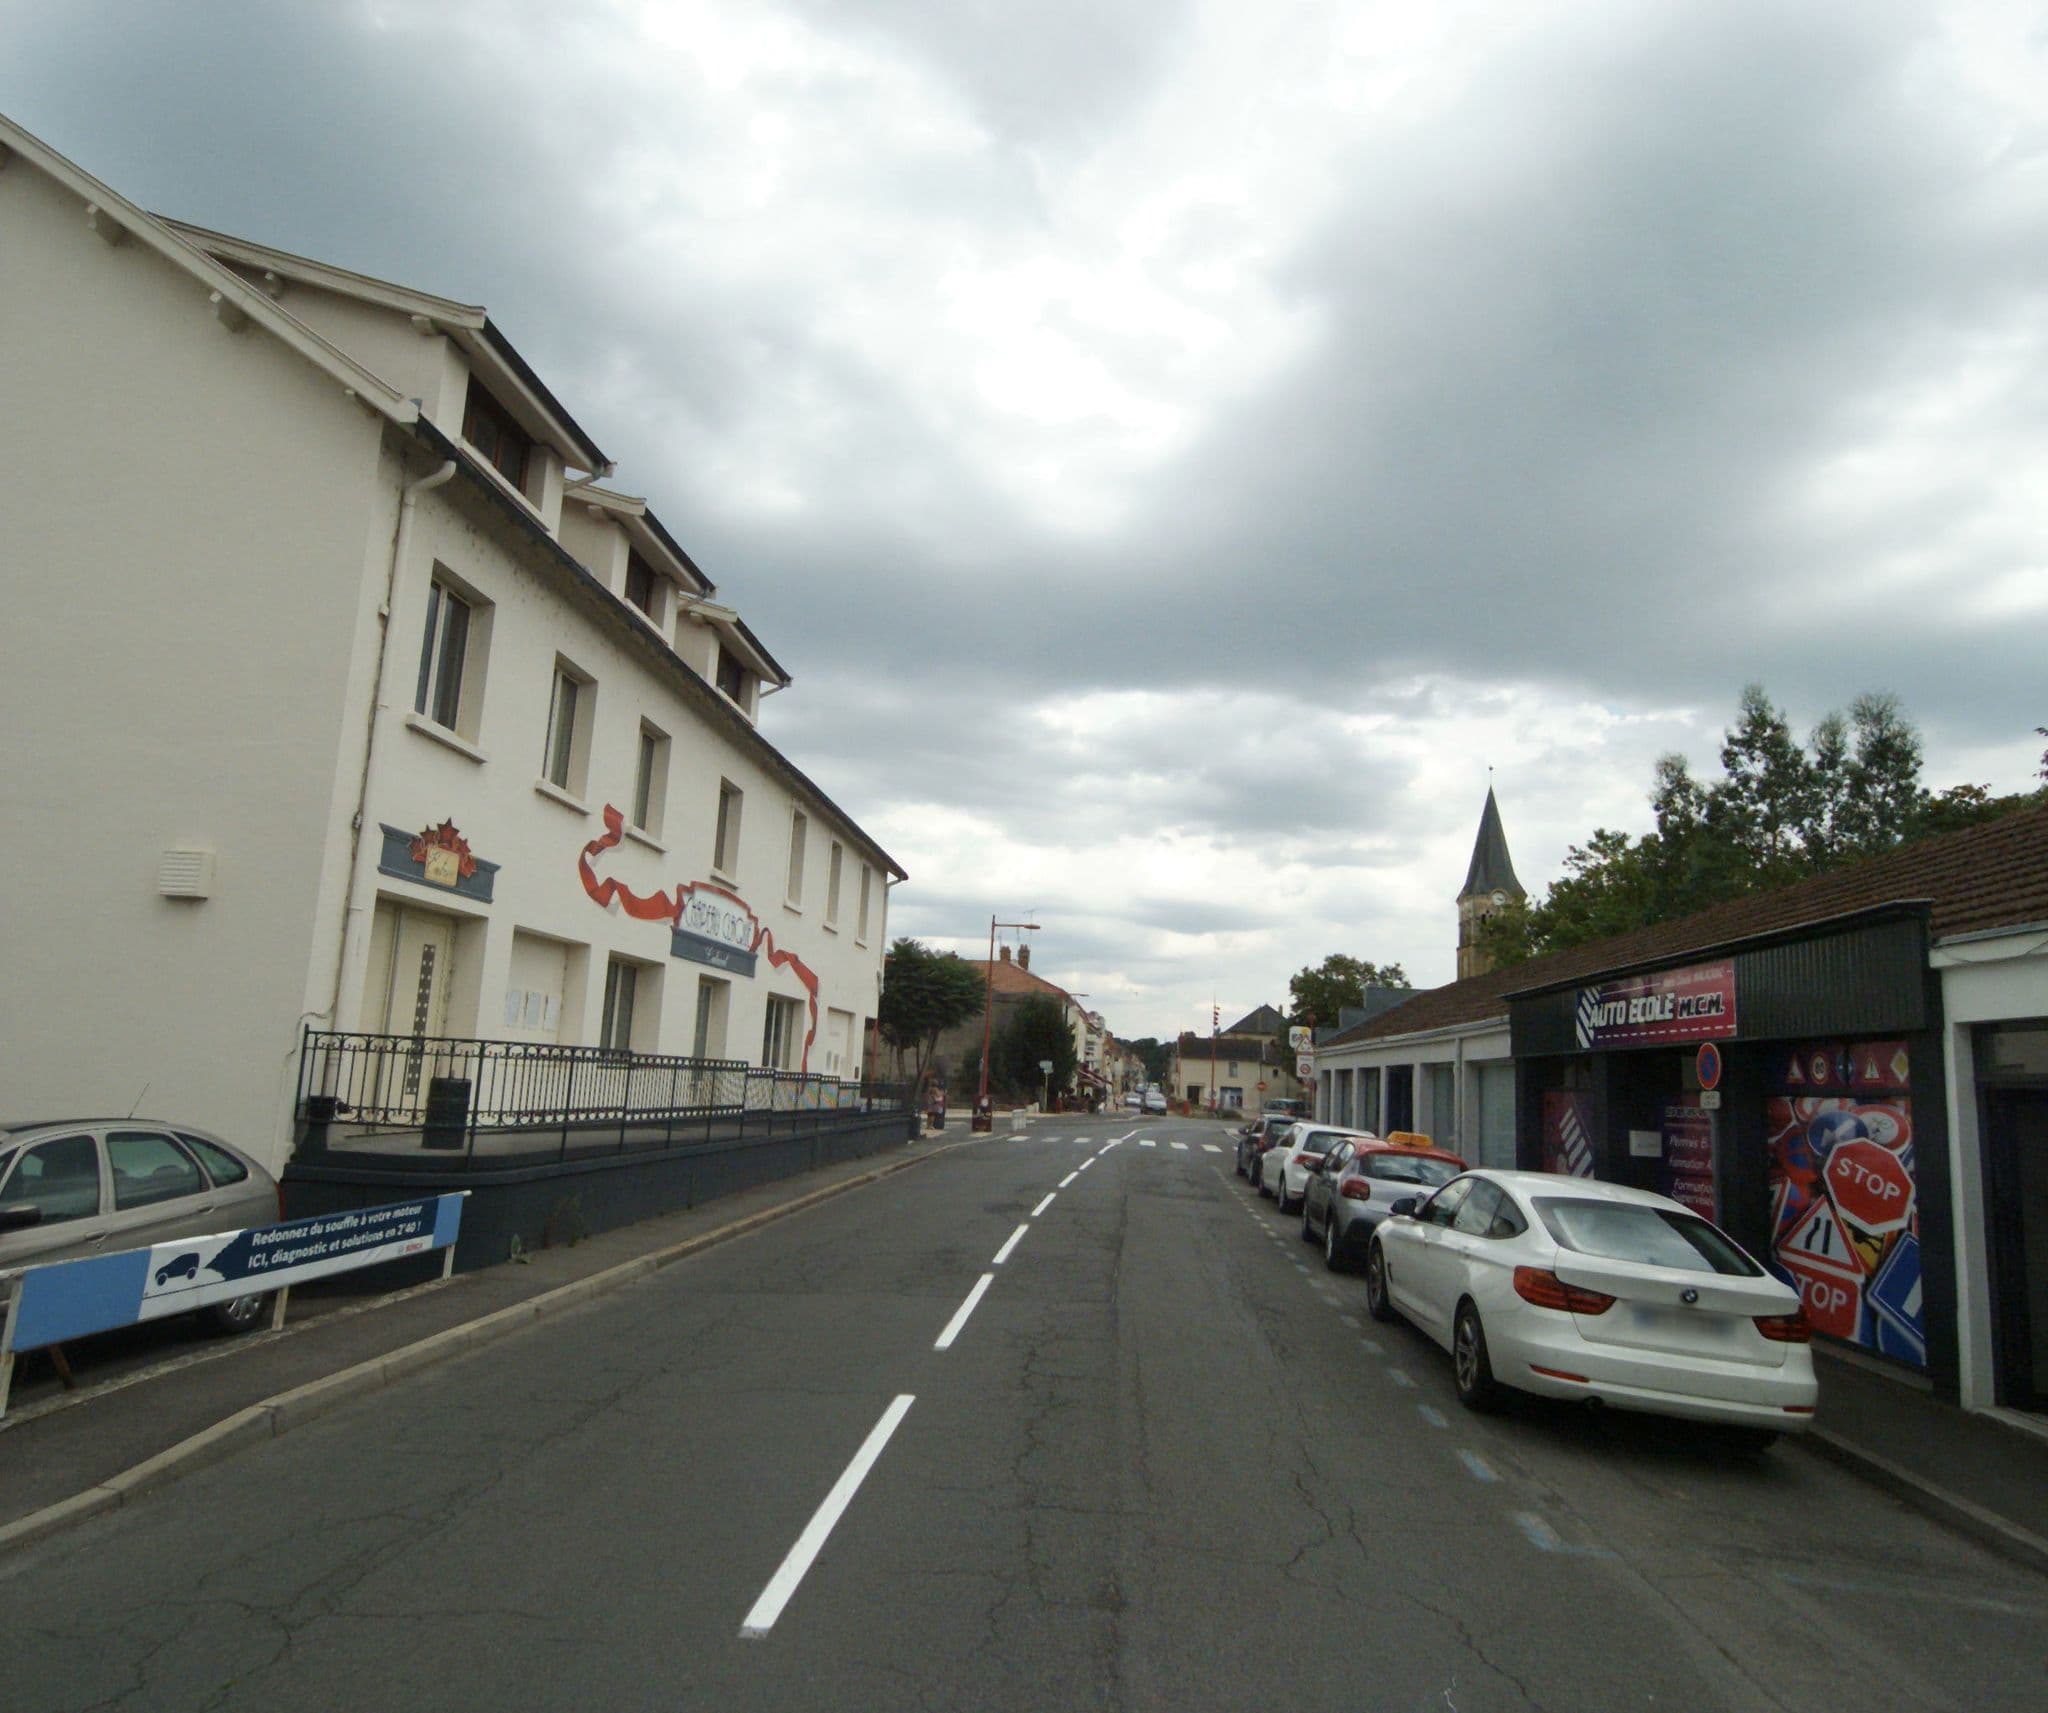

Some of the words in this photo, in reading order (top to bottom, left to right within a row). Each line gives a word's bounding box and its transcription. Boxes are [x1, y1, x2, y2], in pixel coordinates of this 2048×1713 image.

[1589, 1000, 1627, 1028] AUTO
[1628, 992, 1675, 1024] ECOLE
[1677, 992, 1726, 1020] M.C.M.
[1673, 1178, 1713, 1193] Formatio
[1836, 1157, 1901, 1201] STOP
[252, 1227, 309, 1246] Redonnez
[310, 1222, 323, 1235] du
[325, 1215, 359, 1232] souffle
[360, 1212, 367, 1226] à
[368, 1211, 392, 1224] votre
[392, 1205, 423, 1219] moteur
[248, 1253, 269, 1268] ICI,
[271, 1241, 328, 1263] diagnostic
[329, 1239, 339, 1252] et
[341, 1230, 384, 1249] solutions
[385, 1227, 396, 1238] en
[1796, 1275, 1847, 1314] TOP
